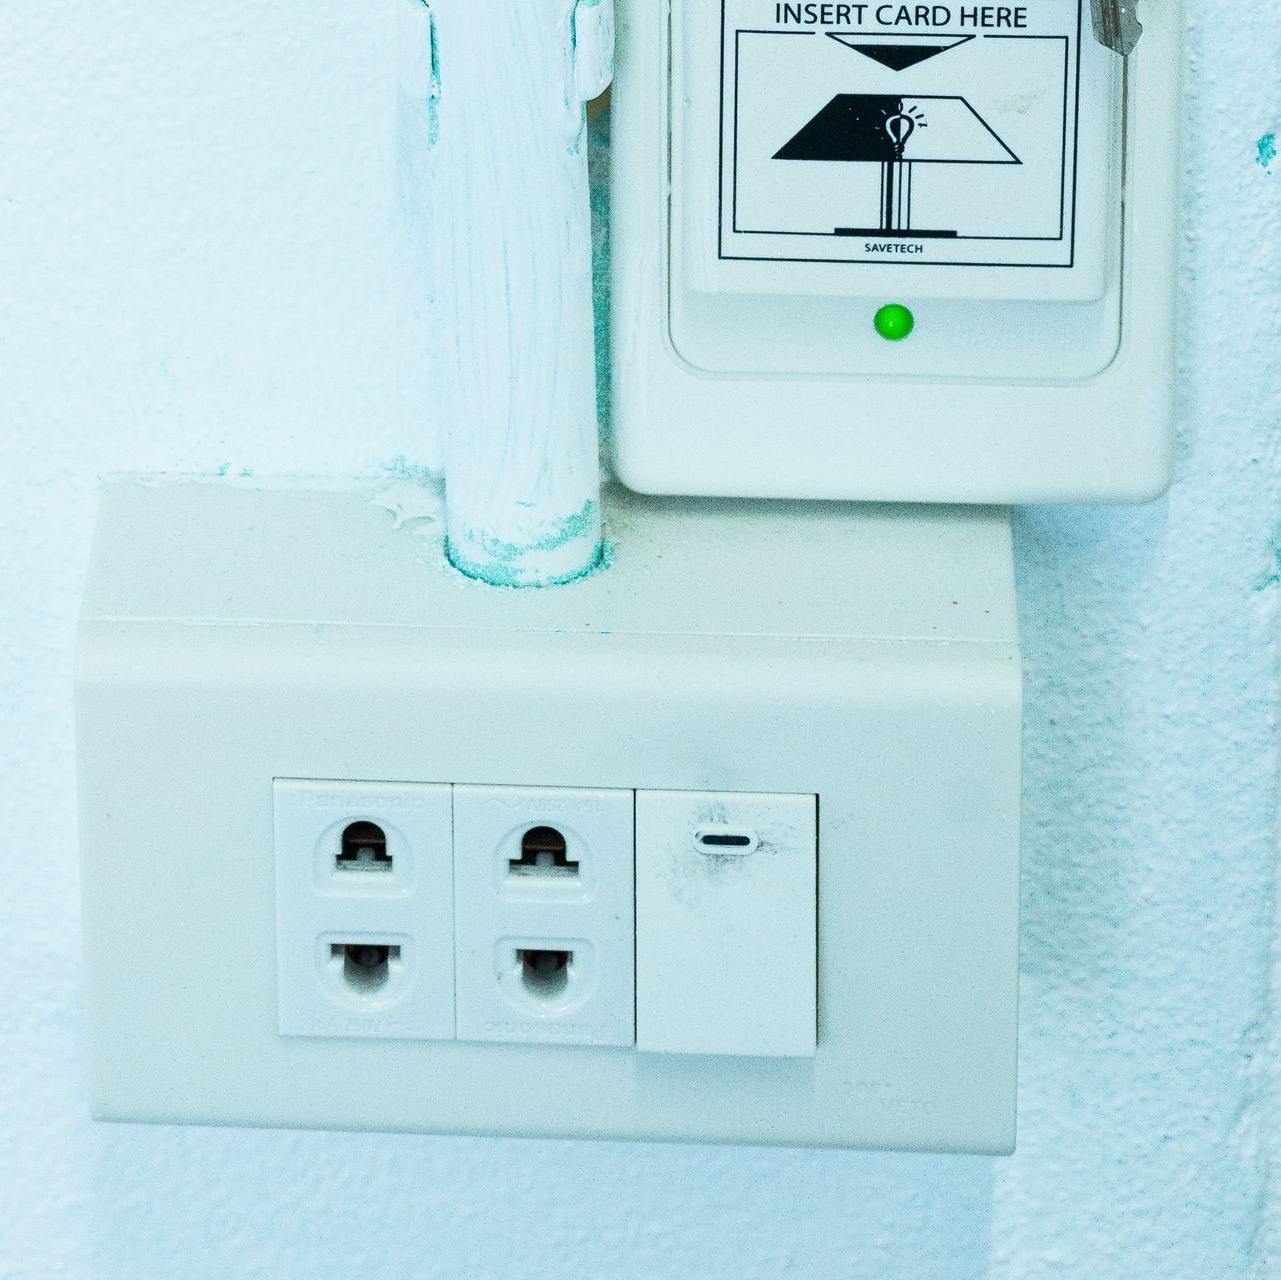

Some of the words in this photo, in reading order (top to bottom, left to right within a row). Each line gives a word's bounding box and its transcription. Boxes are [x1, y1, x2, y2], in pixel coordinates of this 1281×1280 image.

[775, 2, 868, 26] INSERT
[875, 4, 952, 27] CARD
[959, 6, 1028, 29] HERE
[864, 243, 924, 255] SAVETECH
[299, 790, 426, 811] Panasonic
